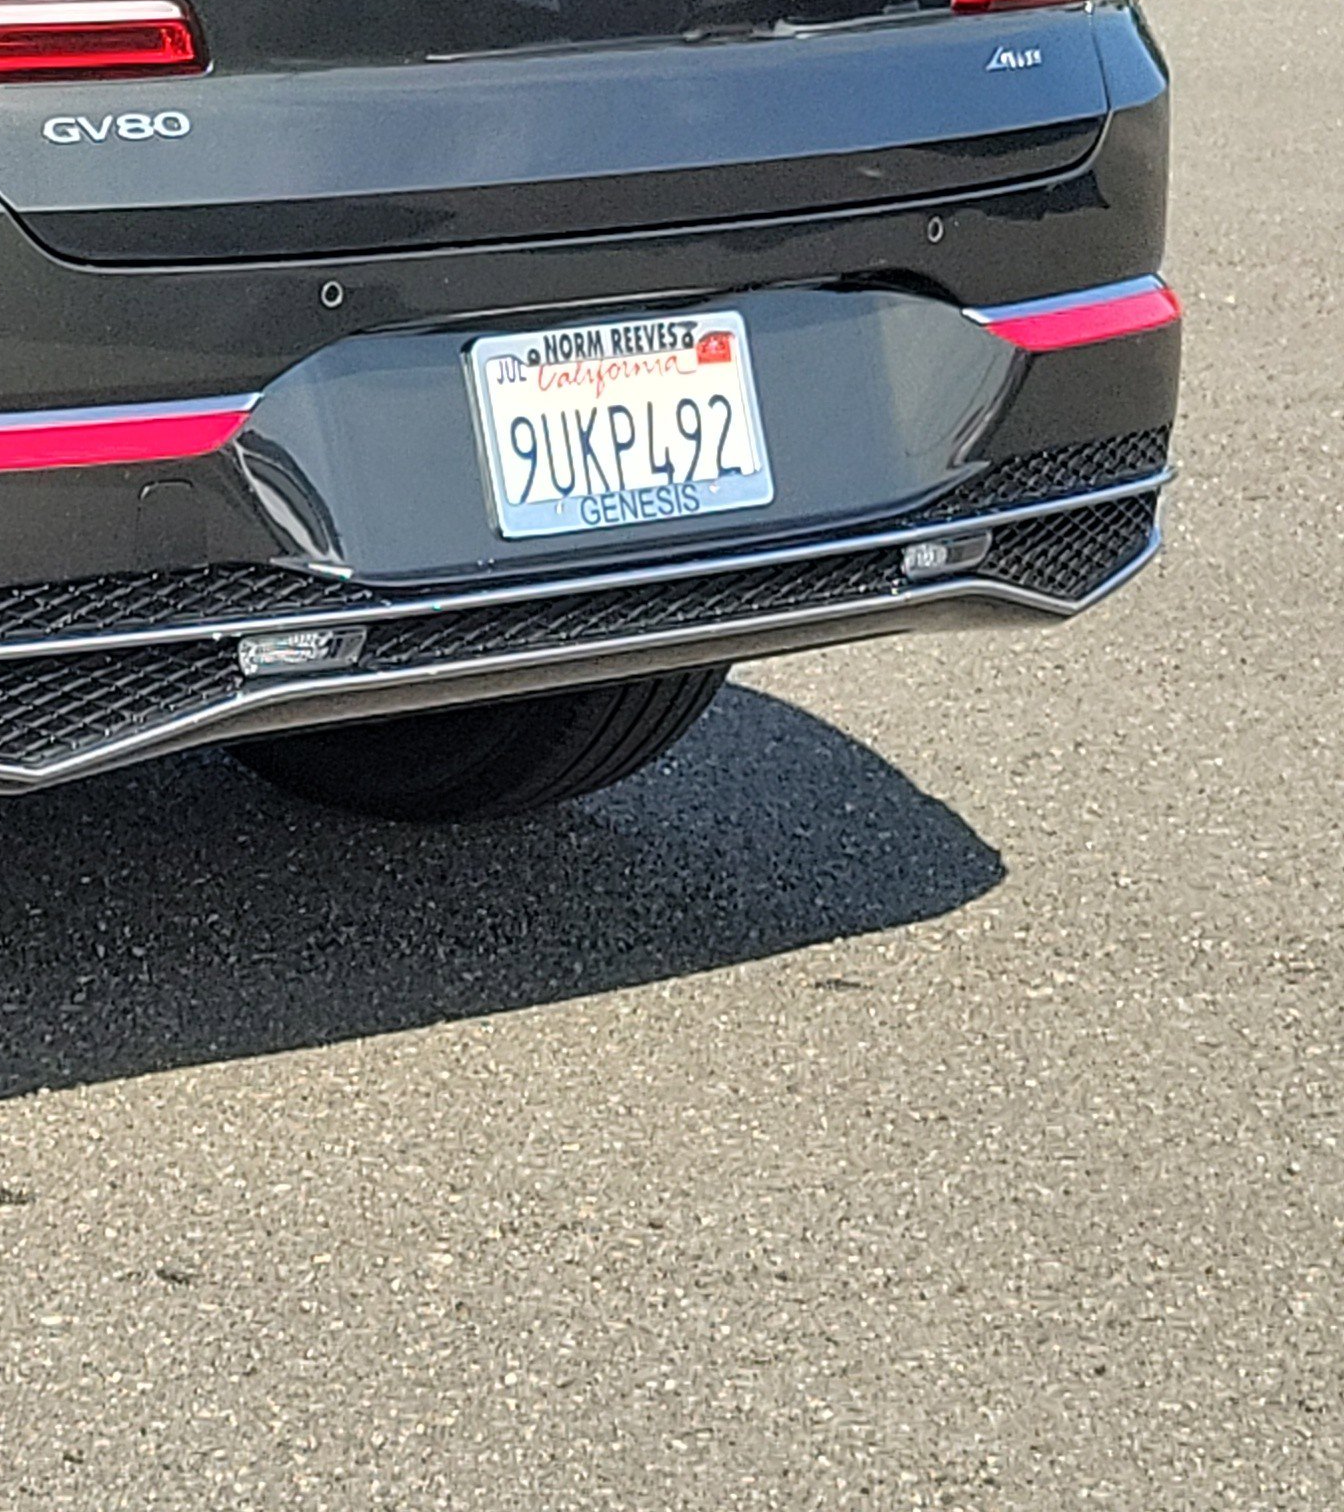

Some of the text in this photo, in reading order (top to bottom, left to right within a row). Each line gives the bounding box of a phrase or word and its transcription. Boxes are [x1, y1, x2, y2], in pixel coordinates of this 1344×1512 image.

[42, 110, 191, 144] GV80
[543, 330, 605, 365] NORM
[611, 322, 678, 356] REEVES
[497, 360, 527, 385] JUL
[538, 354, 697, 399] California
[510, 393, 742, 506] 9UKP492
[580, 483, 702, 526] GENESIS
